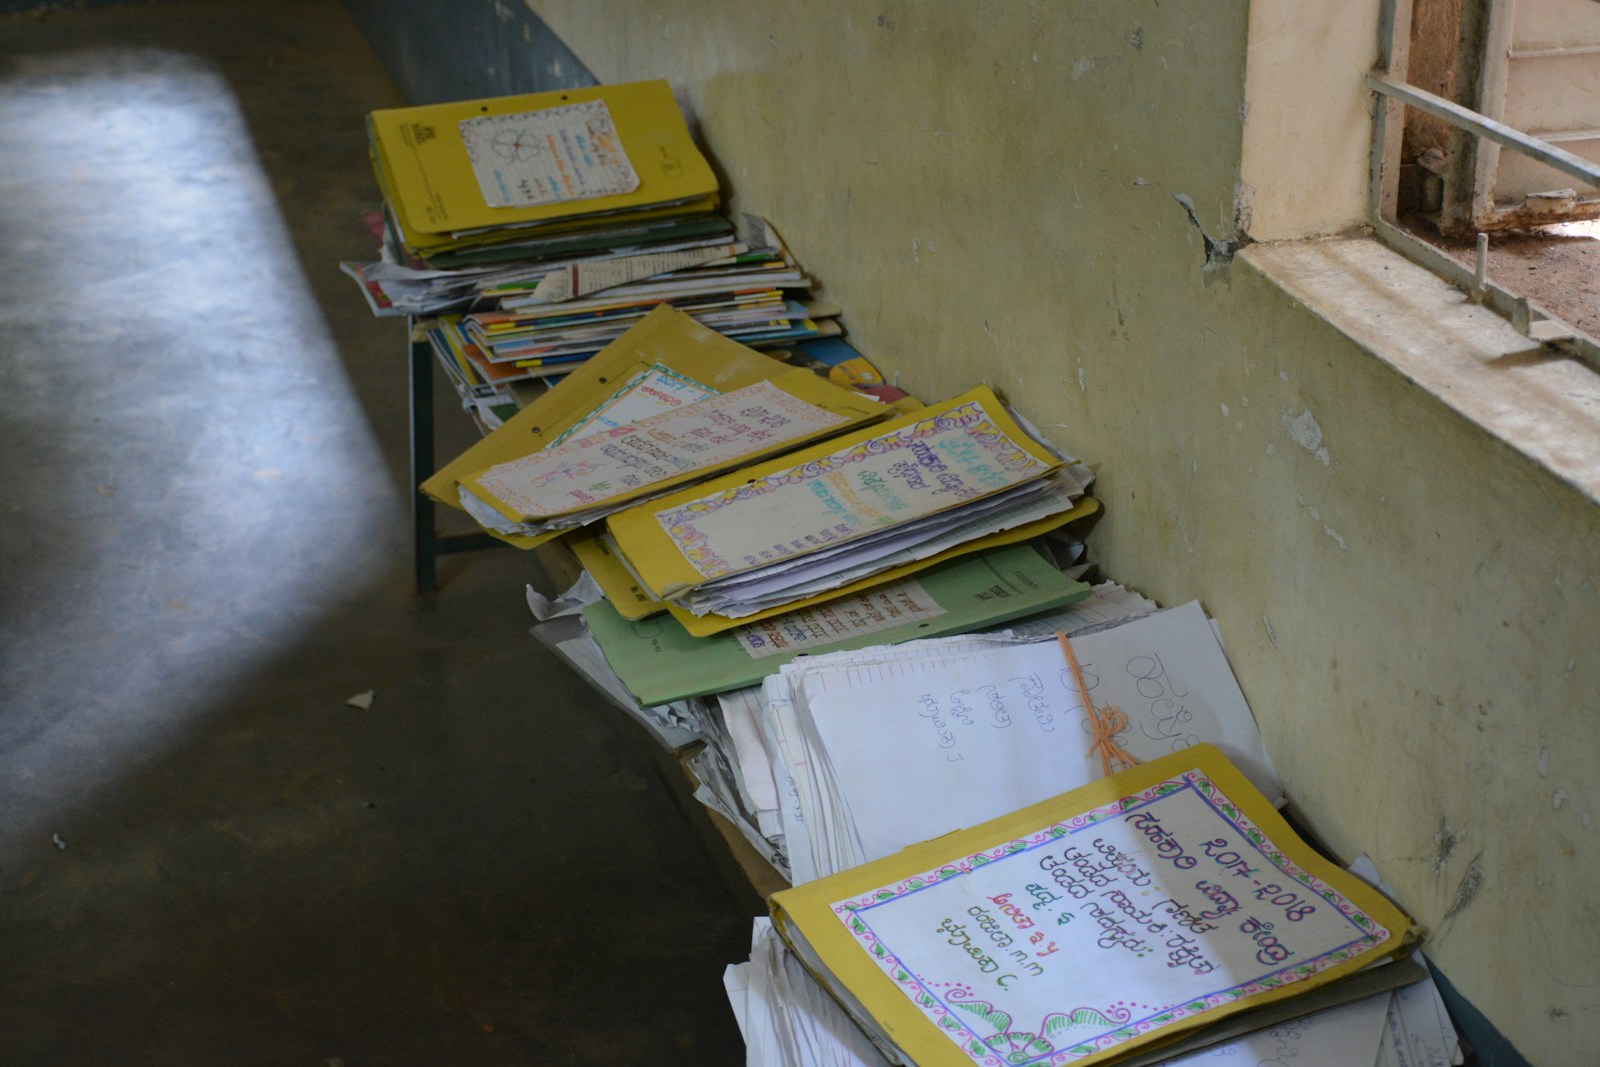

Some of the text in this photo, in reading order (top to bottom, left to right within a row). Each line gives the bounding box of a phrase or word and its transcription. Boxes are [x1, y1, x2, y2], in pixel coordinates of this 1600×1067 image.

[1124, 811, 1295, 967] ಸಹಕಾರಿ ವಿದ್ಯಾ ಕೇಂದ್ರ
